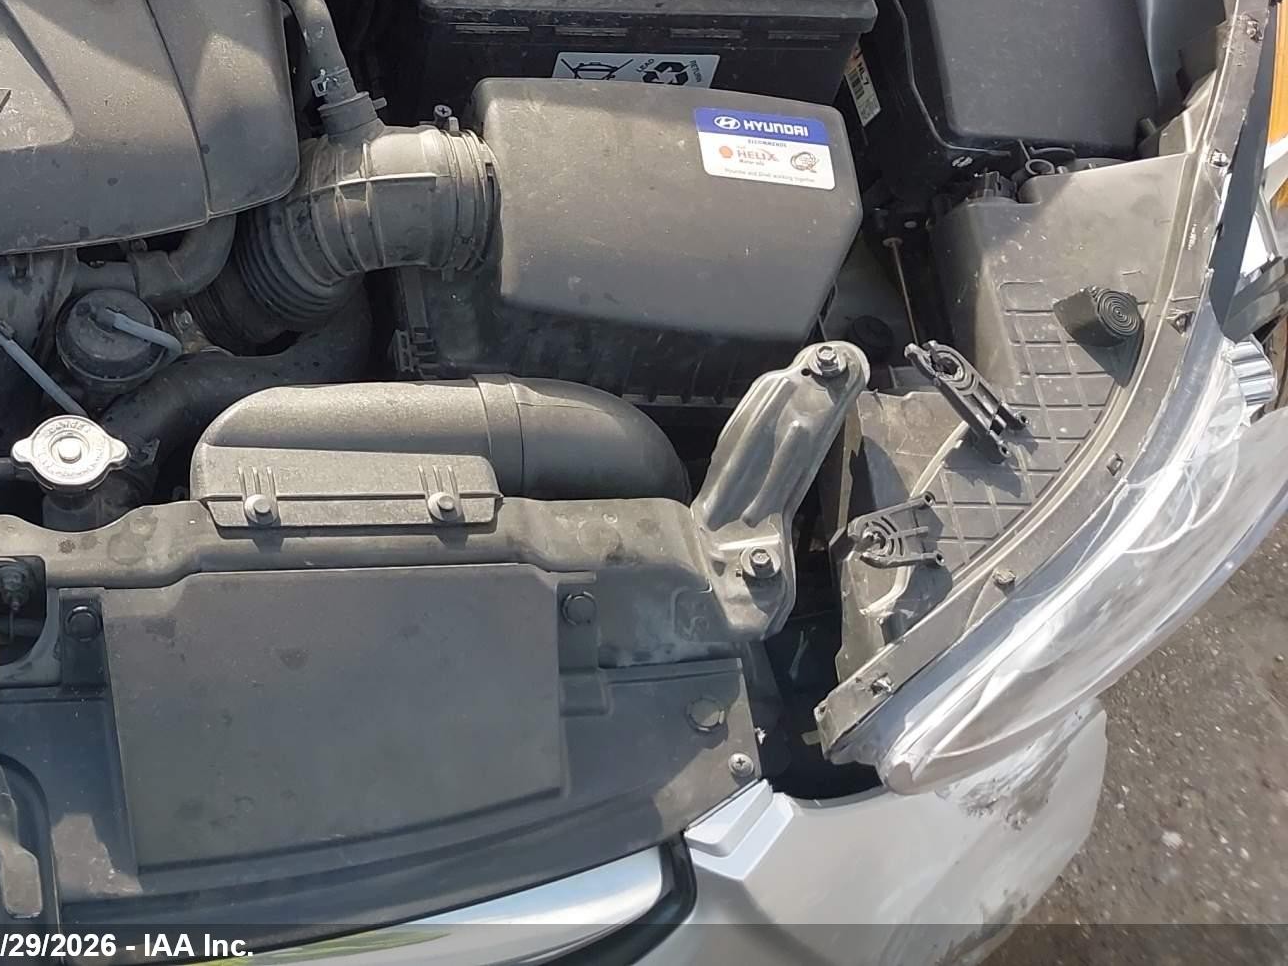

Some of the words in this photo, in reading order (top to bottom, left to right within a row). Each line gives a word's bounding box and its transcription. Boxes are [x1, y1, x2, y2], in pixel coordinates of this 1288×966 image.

[636, 58, 655, 73] LEAD
[743, 119, 809, 137] HYUNDAI
[737, 148, 778, 162] HELIX
